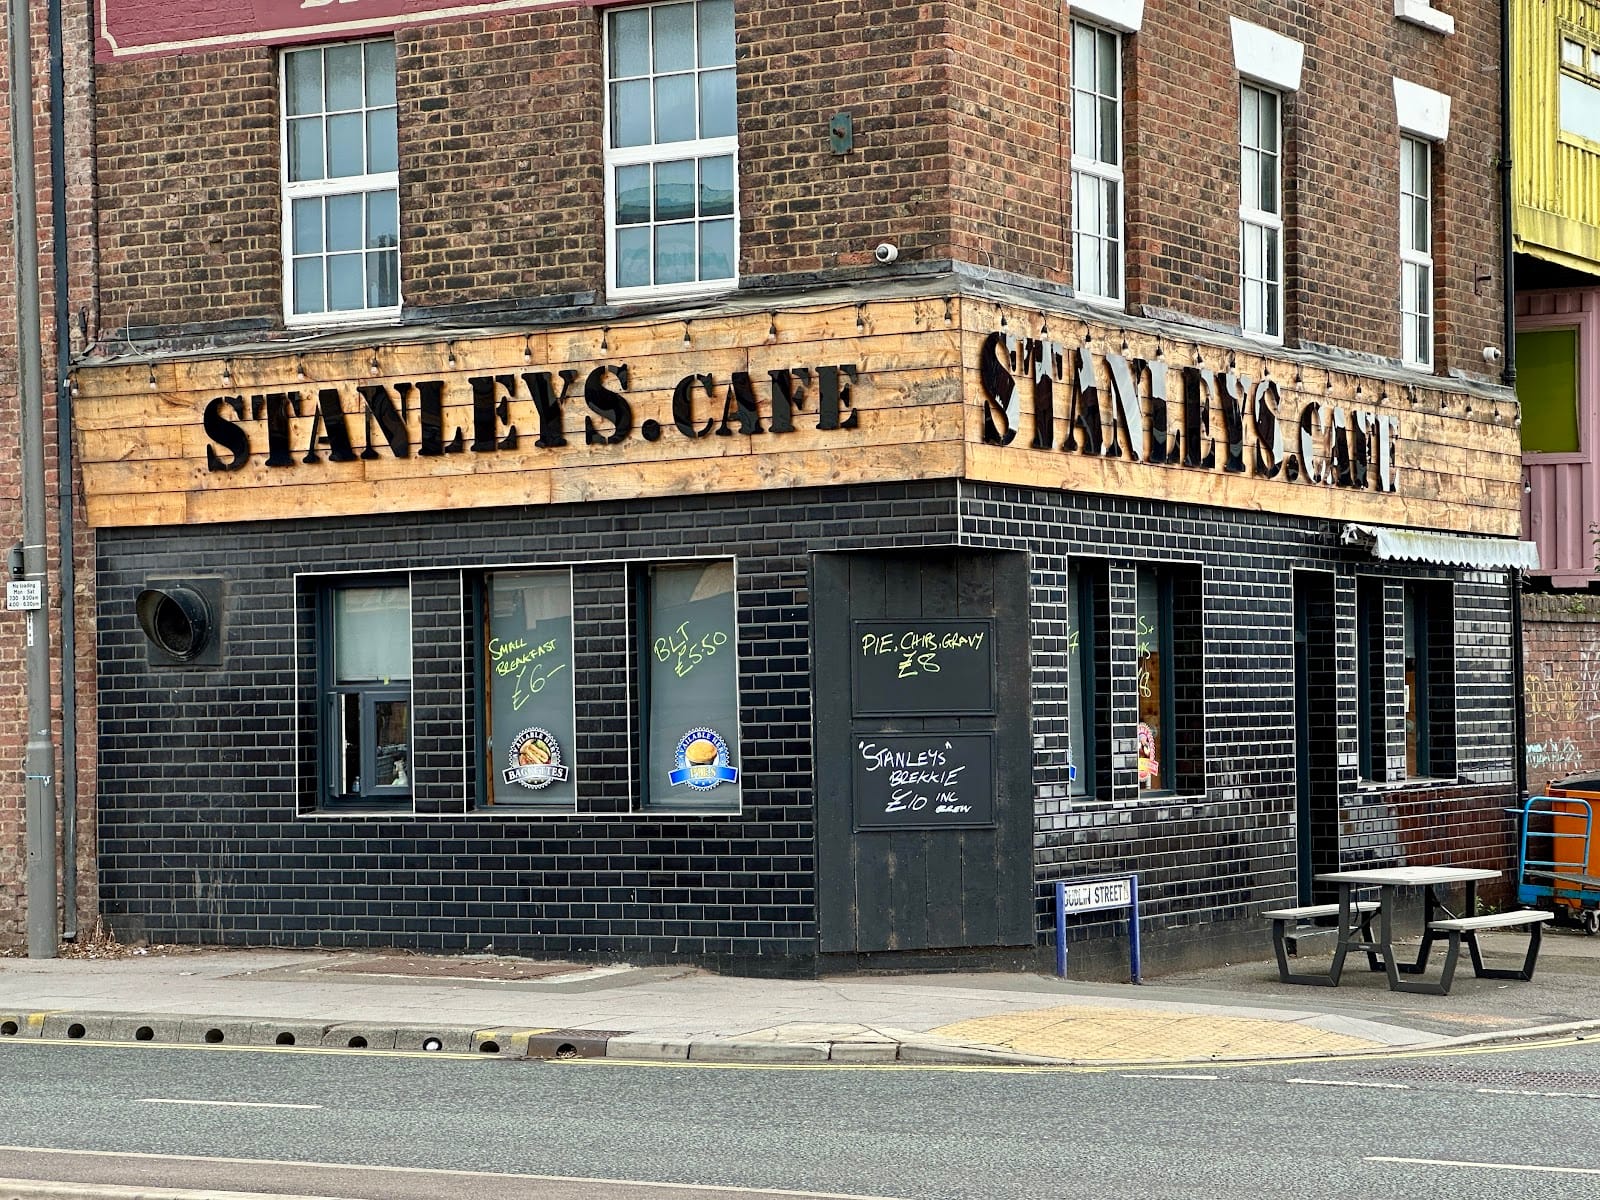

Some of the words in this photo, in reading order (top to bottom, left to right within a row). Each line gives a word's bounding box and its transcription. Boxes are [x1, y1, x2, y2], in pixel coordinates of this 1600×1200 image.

[488, 637, 528, 660] SMALL
[654, 620, 690, 662] BLT
[495, 638, 557, 677] BREAKFAST
[898, 650, 941, 678] £8
[888, 765, 967, 787] BREKKIE
[884, 788, 928, 813] £10
[935, 791, 959, 802] INC
[1094, 884, 1123, 904] STREET
